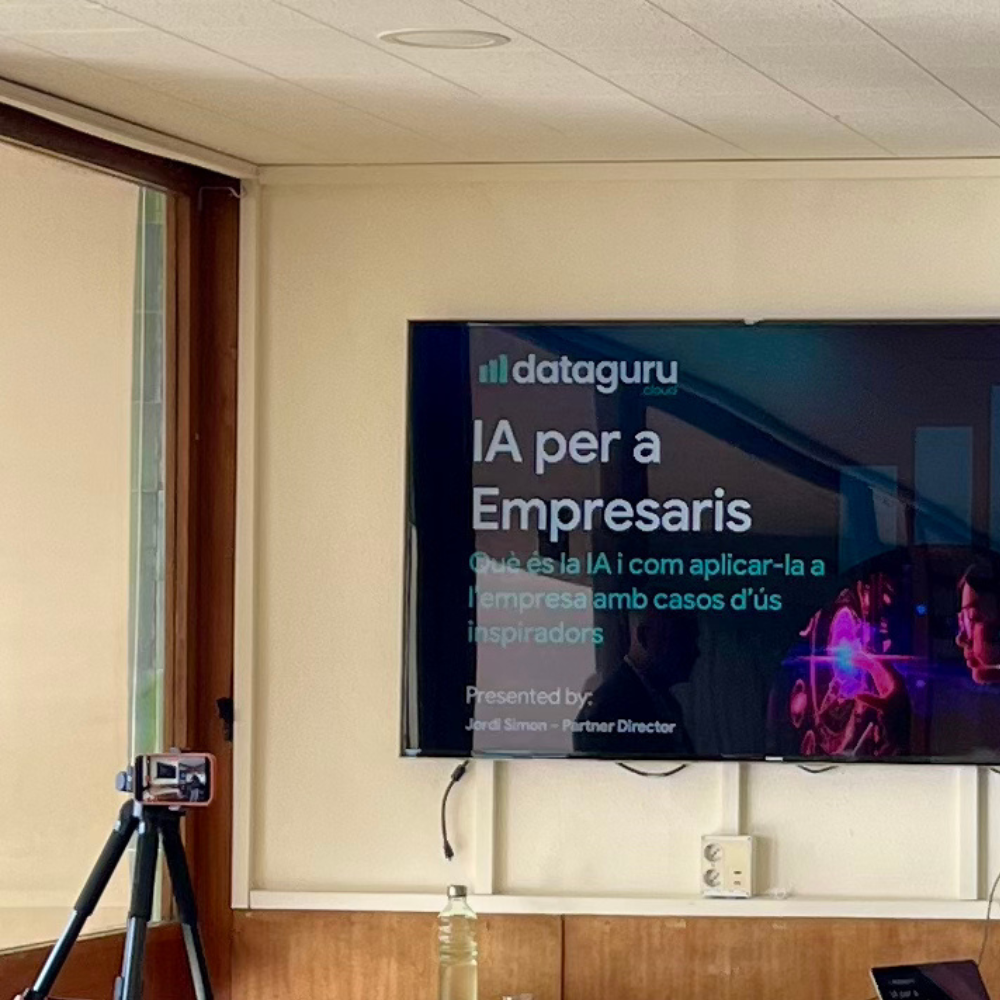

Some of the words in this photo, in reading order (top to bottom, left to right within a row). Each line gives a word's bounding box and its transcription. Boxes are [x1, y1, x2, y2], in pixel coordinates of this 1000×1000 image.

[512, 353, 678, 394] dataguru
[473, 419, 523, 462] IA
[534, 429, 621, 475] per
[633, 429, 661, 464] a
[472, 486, 752, 543] Empresaris
[469, 551, 521, 575] Què
[527, 551, 555, 575] és
[560, 552, 581, 575] la
[586, 552, 612, 575] IA
[617, 552, 623, 575] i
[628, 557, 684, 575] com
[689, 552, 805, 581] aplicar-la
[810, 558, 825, 576] a
[594, 586, 648, 610] amb
[653, 592, 725, 610] casos
[468, 620, 604, 648] inspiradors
[466, 686, 560, 705] Presented
[565, 687, 594, 709] by:
[465, 718, 501, 732] Jordi
[503, 718, 547, 732] Simon
[562, 719, 615, 733] Partner
[616, 719, 677, 733] Director
